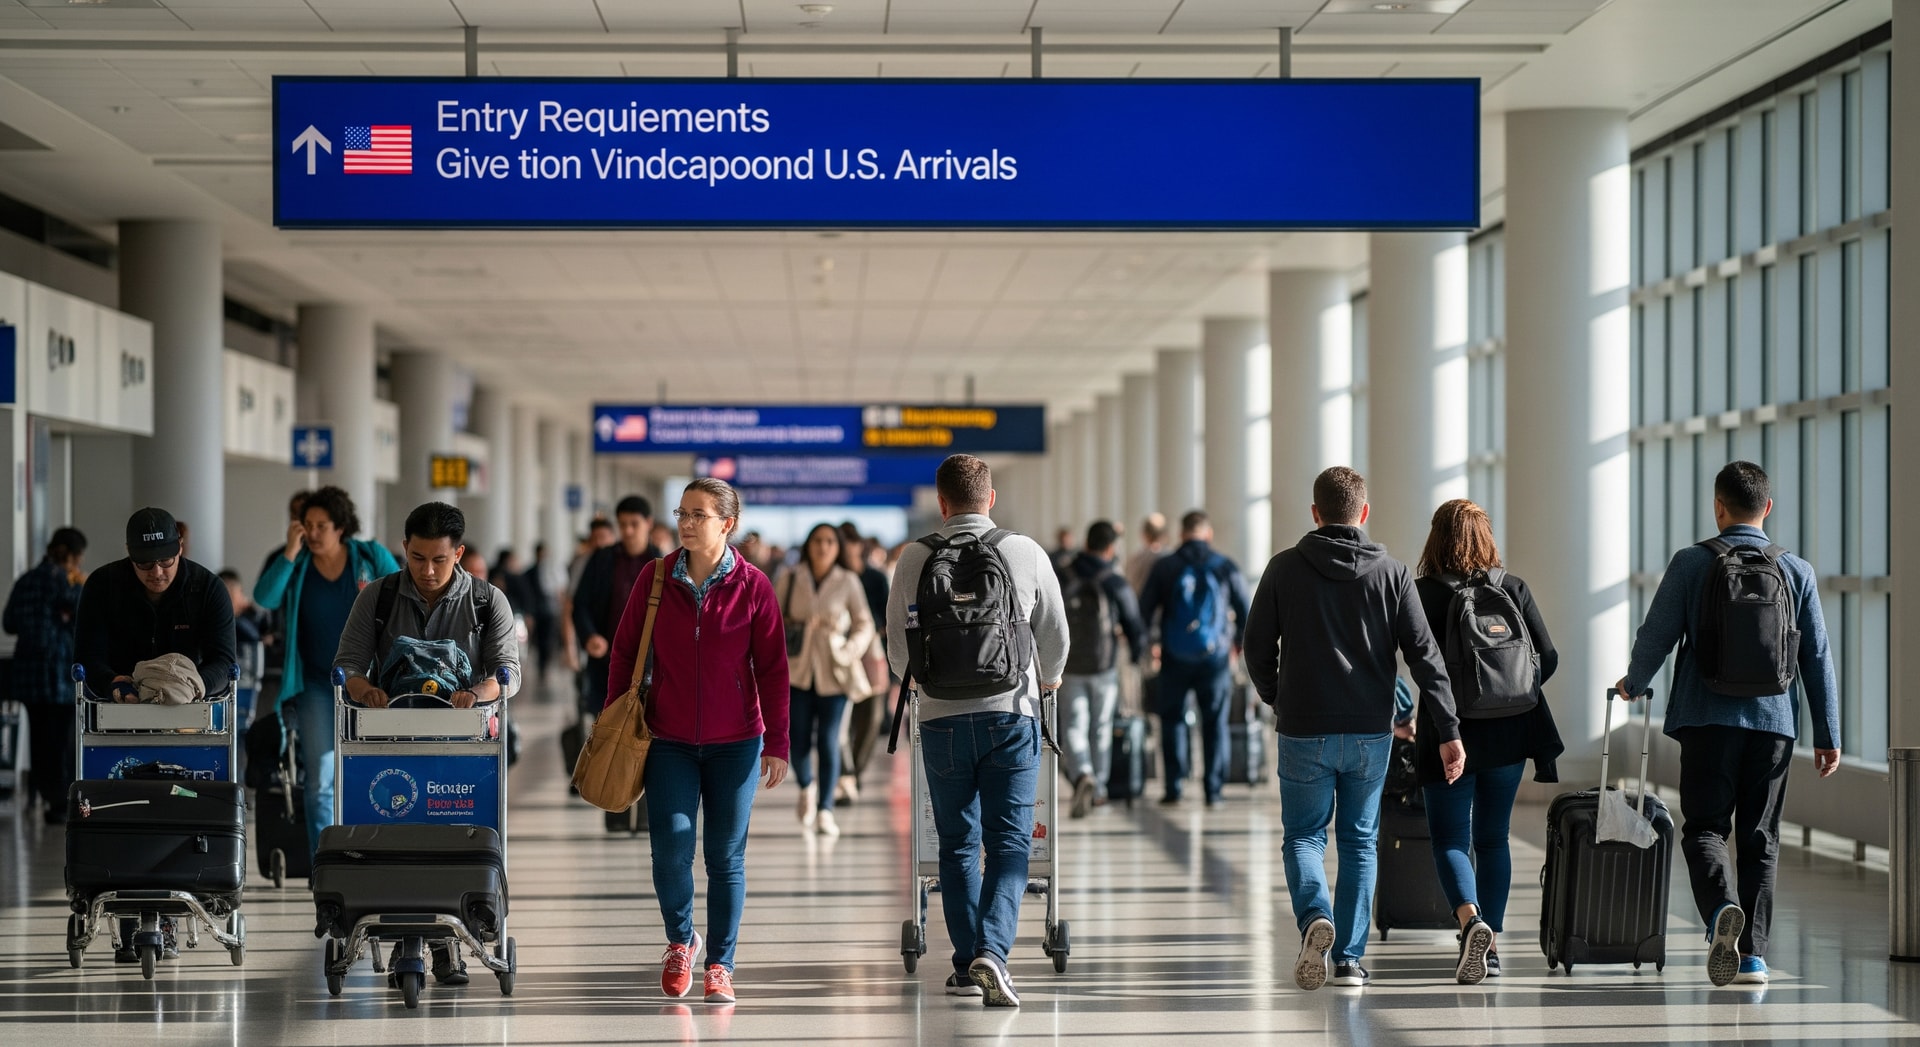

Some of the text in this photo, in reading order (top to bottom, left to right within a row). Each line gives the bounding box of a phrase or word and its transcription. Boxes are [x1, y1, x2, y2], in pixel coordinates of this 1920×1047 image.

[437, 100, 770, 140] Entry Requiements
[436, 147, 1018, 187] Give tion Vindcapoond U.S. Arrivals
